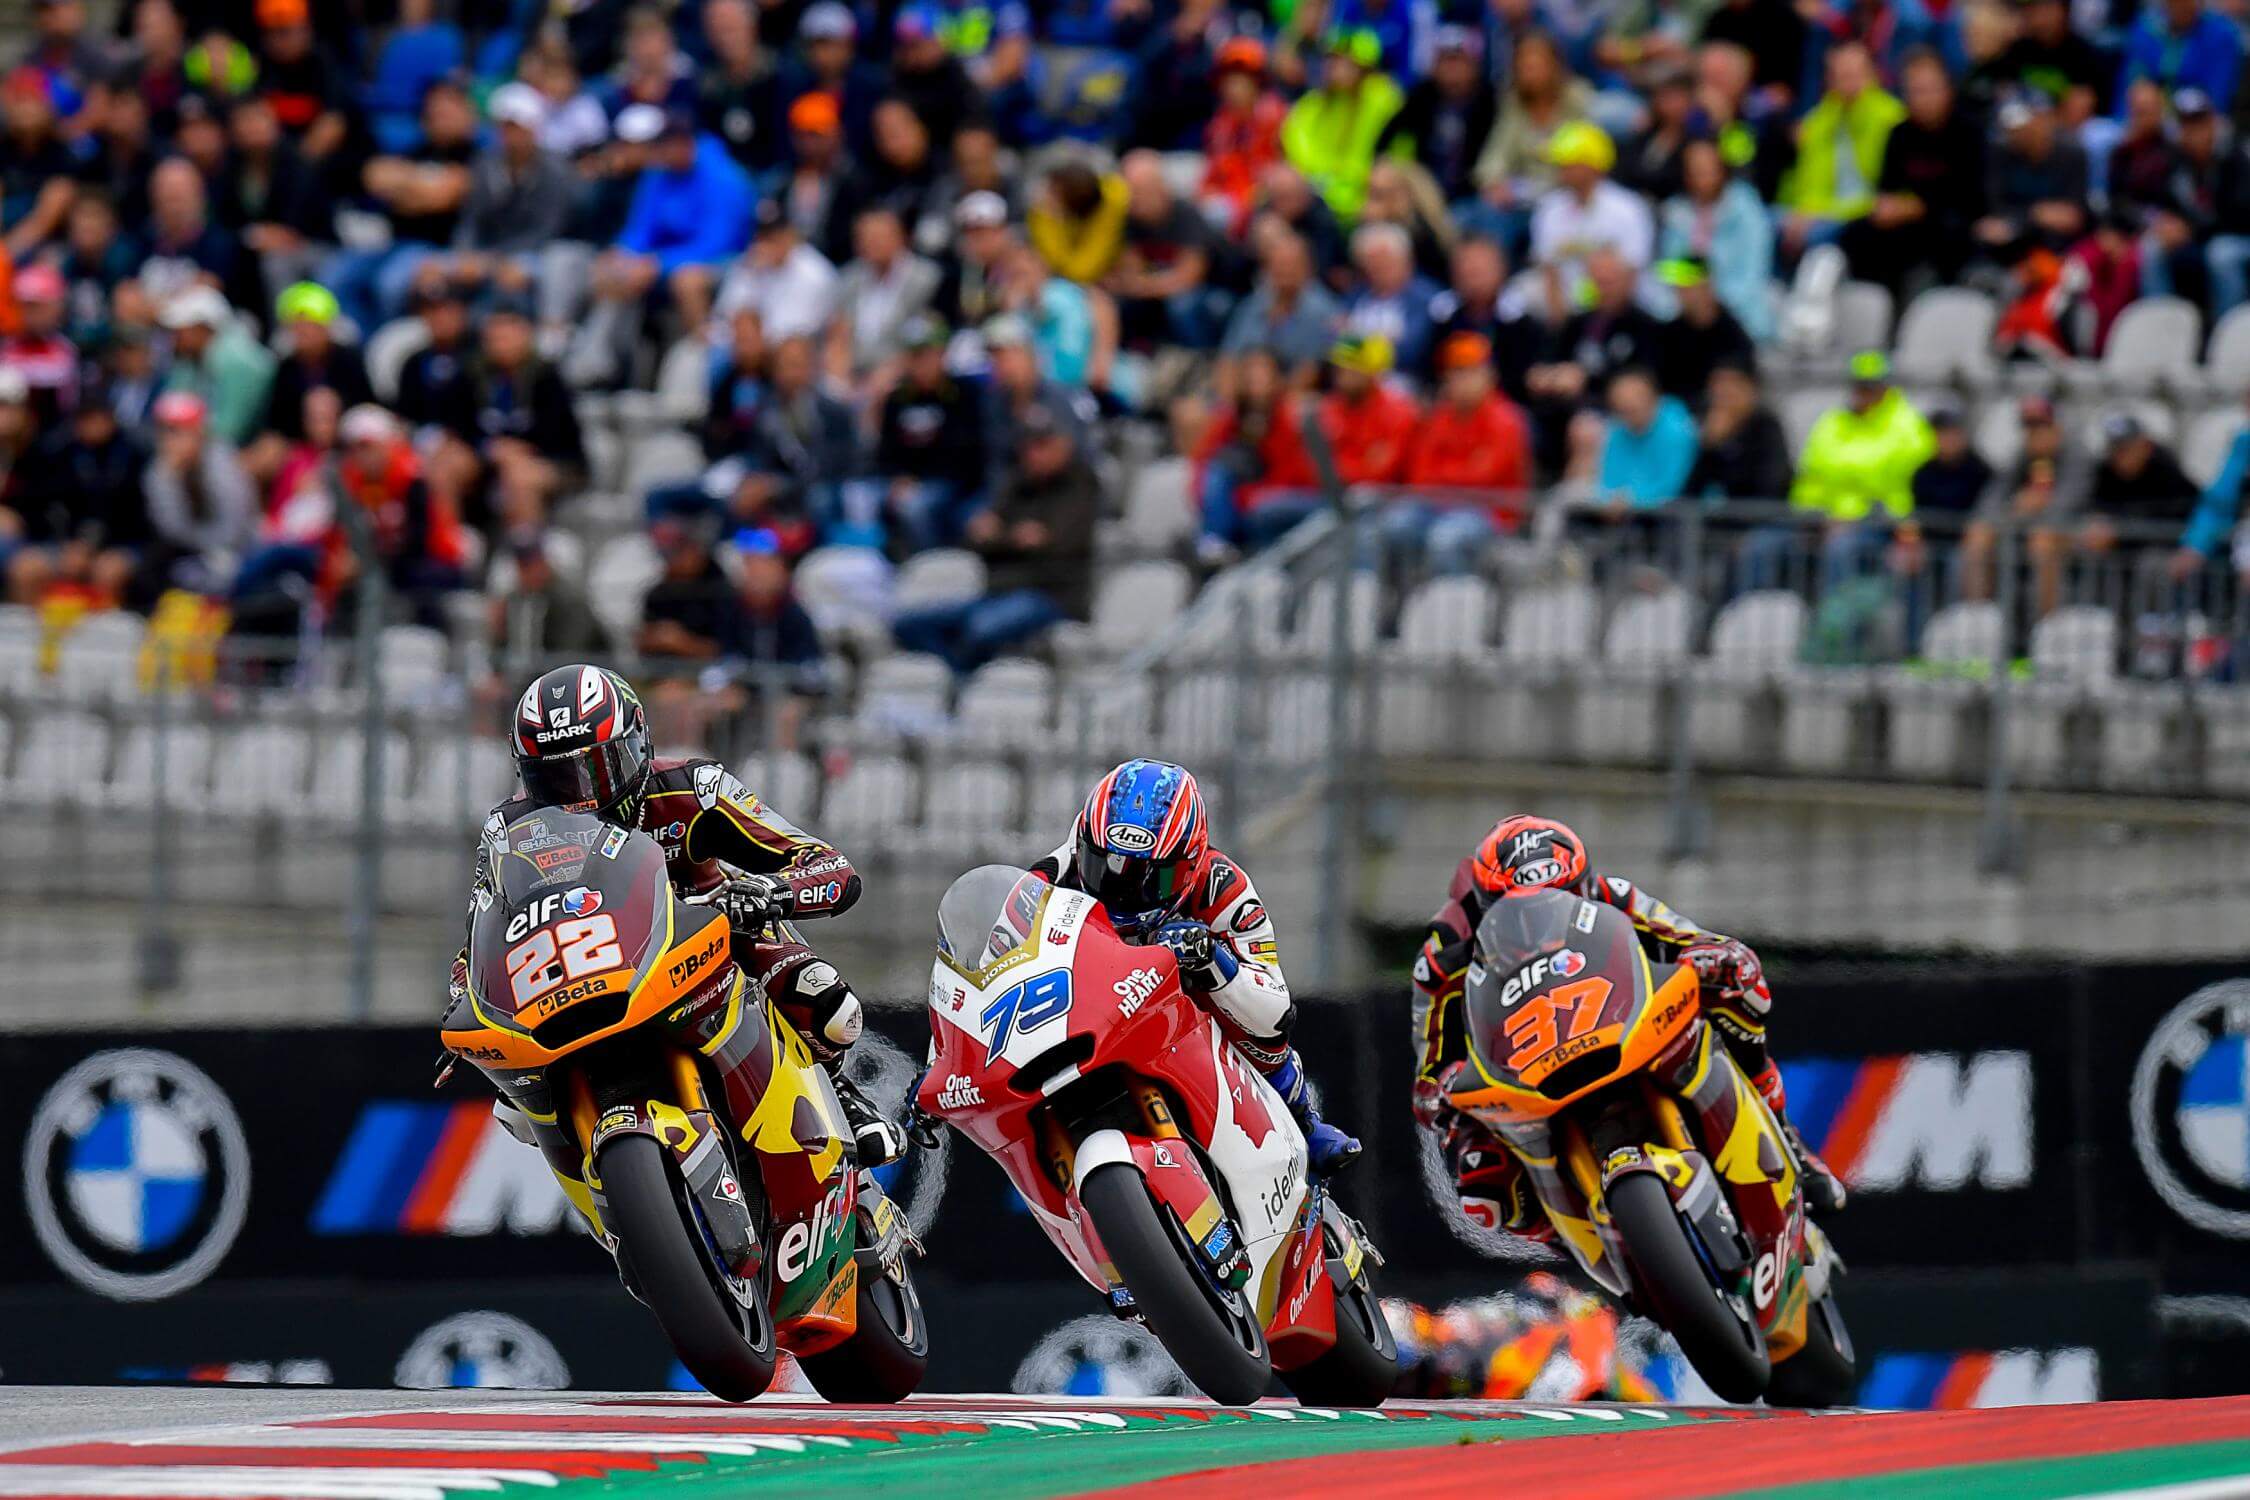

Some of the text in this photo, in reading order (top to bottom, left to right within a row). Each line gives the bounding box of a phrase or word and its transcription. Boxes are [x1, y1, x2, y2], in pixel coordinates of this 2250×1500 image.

[537, 722, 592, 743] SHARK
[1110, 827, 1151, 845] Arai
[799, 885, 827, 904] elf
[506, 893, 560, 943] elf
[505, 913, 624, 1010] 22
[685, 937, 724, 978] Beta
[981, 953, 1033, 986] HONDA
[554, 979, 608, 1007] Beta
[1113, 967, 1146, 996] One
[1500, 957, 1549, 1007] elf
[980, 966, 1074, 1069] 79
[1504, 976, 1614, 1071] 37
[1555, 1035, 1600, 1065] Beta
[945, 1074, 972, 1092] One
[777, 1185, 839, 1283] elf
[1754, 1214, 1793, 1310] elf
